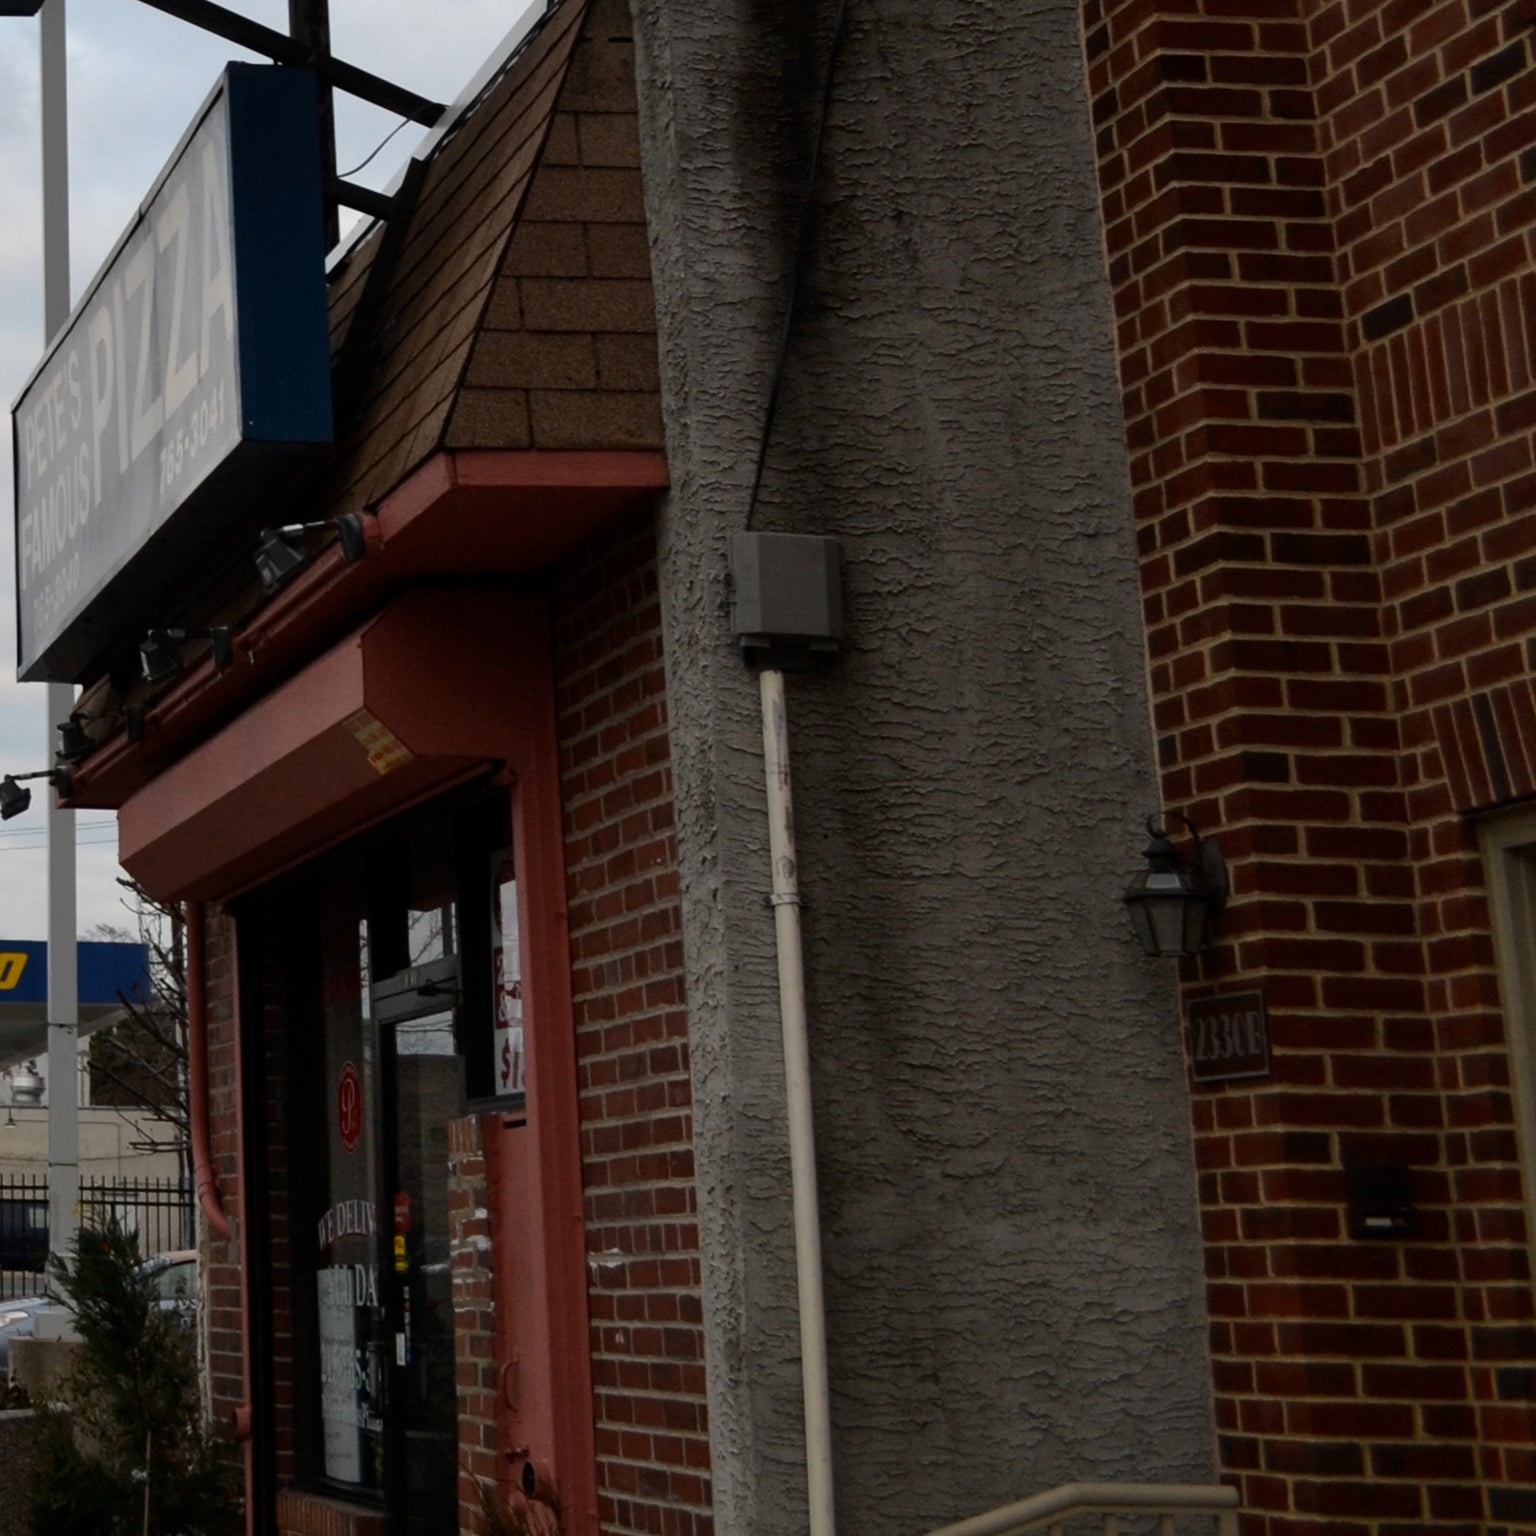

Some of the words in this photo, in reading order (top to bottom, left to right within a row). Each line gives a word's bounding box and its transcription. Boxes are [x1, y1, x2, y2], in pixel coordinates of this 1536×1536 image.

[87, 140, 234, 509] PIZZA
[24, 349, 82, 491] PETE'S
[21, 440, 90, 591] FAMOUS
[1191, 1011, 1263, 1062] 2330B
[318, 1207, 336, 1253] WE
